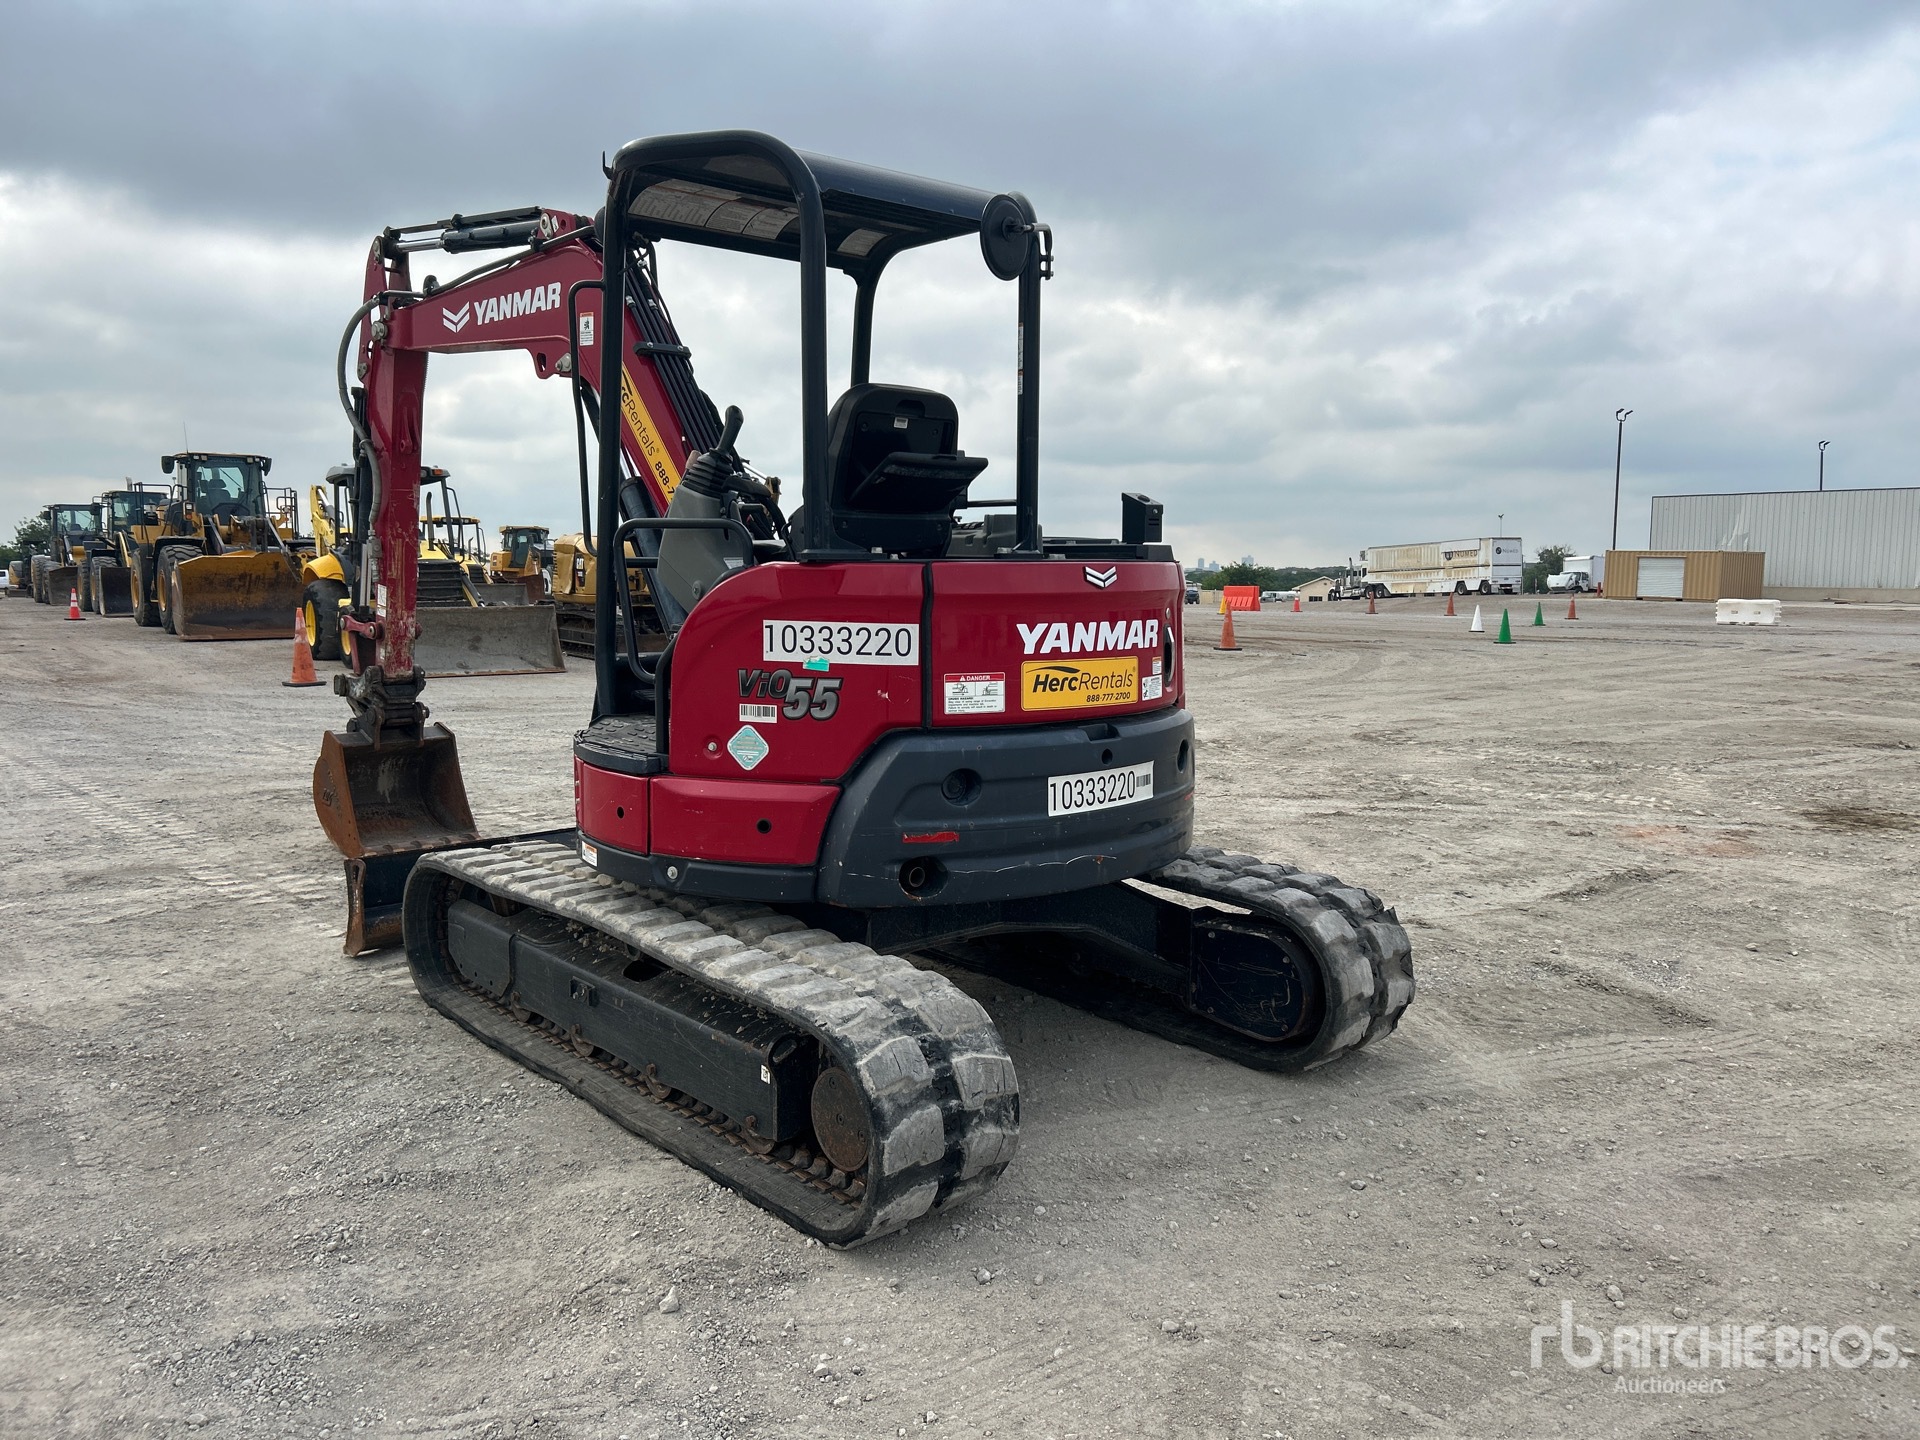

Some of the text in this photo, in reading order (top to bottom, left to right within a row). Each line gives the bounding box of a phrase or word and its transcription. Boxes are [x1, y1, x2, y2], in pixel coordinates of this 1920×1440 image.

[474, 282, 561, 325] YANMAR
[654, 461, 676, 501] 888-7
[576, 558, 584, 569] CAT
[764, 624, 912, 657] 10333220
[1016, 619, 1159, 654] YANMAR
[1086, 692, 1131, 703] 888-777-2700
[1050, 771, 1135, 811] 10333220
